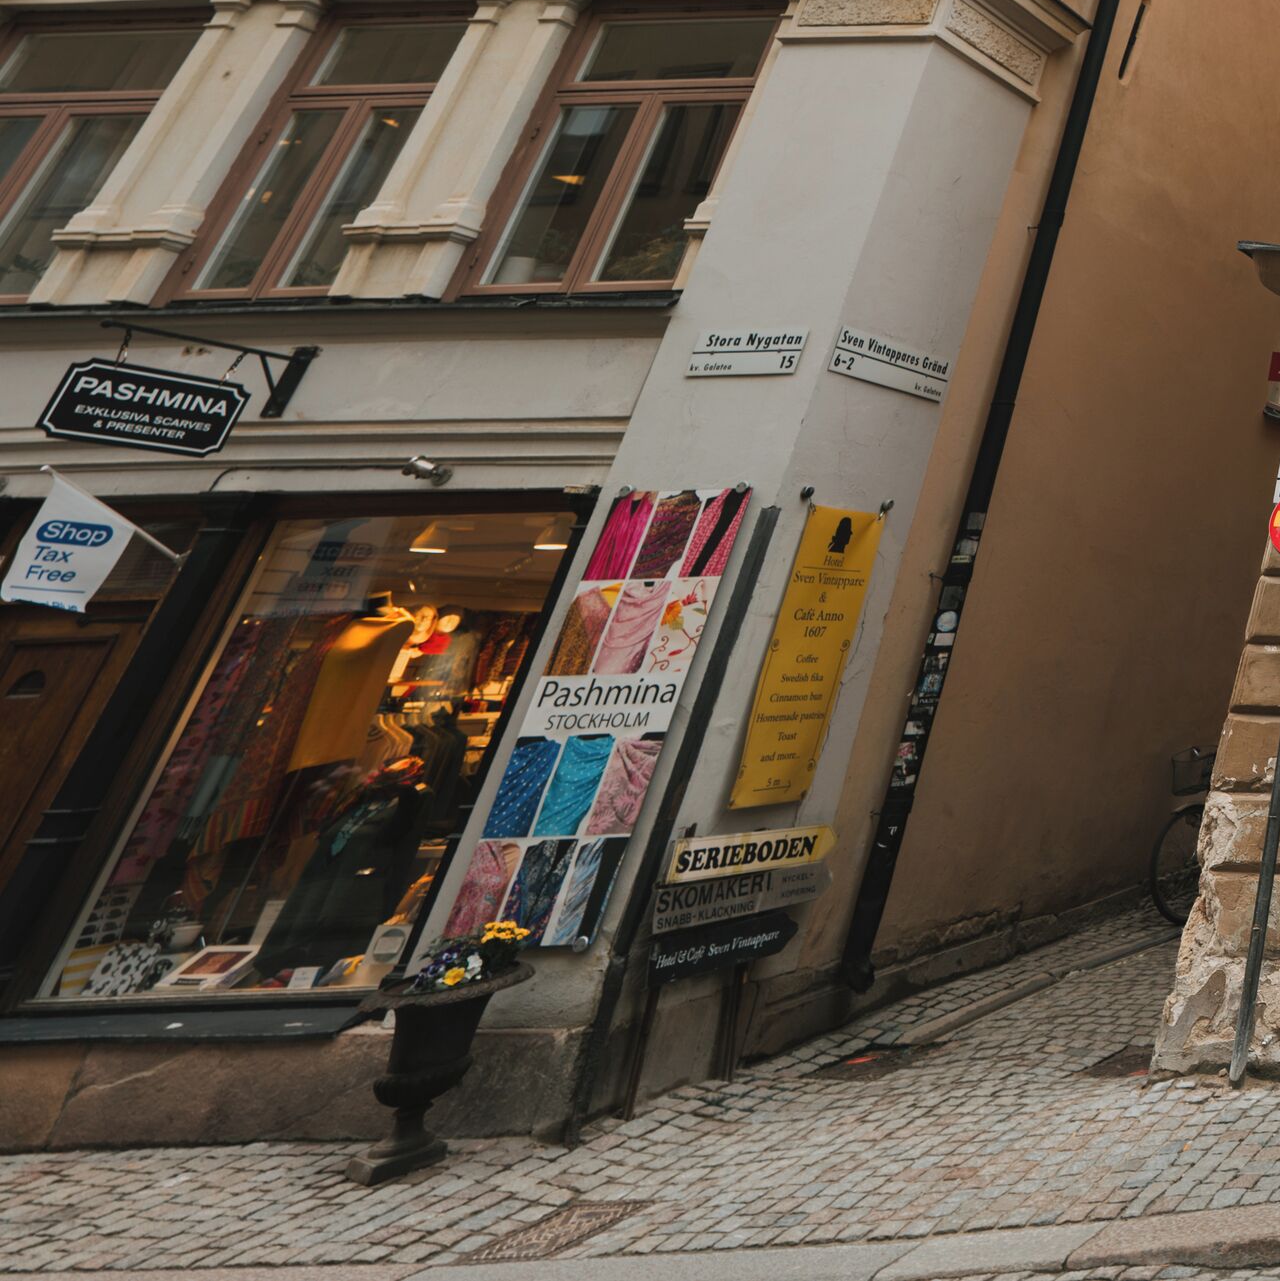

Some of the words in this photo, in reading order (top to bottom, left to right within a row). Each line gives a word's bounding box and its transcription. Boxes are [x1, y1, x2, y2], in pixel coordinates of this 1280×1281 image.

[706, 334, 741, 347] Stora
[746, 332, 802, 350] Nygatan
[779, 355, 795, 369] 15
[841, 330, 864, 348] Sven
[868, 339, 919, 366] Vintappares
[923, 356, 948, 376] Gränd
[703, 362, 732, 371] Galatea
[833, 356, 855, 370] 6-2
[73, 376, 227, 417] PASHMINA
[74, 403, 150, 424] EXKLUSIVA
[153, 415, 211, 433] SCARVES
[93, 420, 103, 429] &
[106, 420, 186, 440] PRESENTER
[42, 522, 108, 547] Shop
[34, 545, 74, 564] Tax
[823, 555, 846, 567] Hotel
[25, 565, 76, 583] Free
[793, 571, 815, 583] Sven
[818, 572, 865, 590] Vintappare
[818, 592, 827, 603] &
[794, 608, 815, 621] Café
[817, 610, 844, 621] Anno
[803, 626, 827, 638] 1607
[796, 654, 819, 664] Coffee
[780, 673, 809, 683] Swedish
[810, 672, 824, 682] fika
[537, 678, 677, 708] Pashmina
[769, 693, 808, 703] Cinnamon
[809, 692, 823, 701] bun
[544, 712, 650, 731] STOCKHOLM
[756, 712, 799, 723] Homemade
[800, 712, 826, 723] pastries
[778, 731, 797, 741] Toast
[760, 752, 775, 762] and
[675, 835, 818, 874] SERIEBODEN
[656, 872, 772, 914] SKOMAKERI
[655, 951, 678, 969] Hotel
[677, 950, 687, 963] &
[707, 943, 730, 957] Sven
[731, 930, 781, 950] Vintappare
